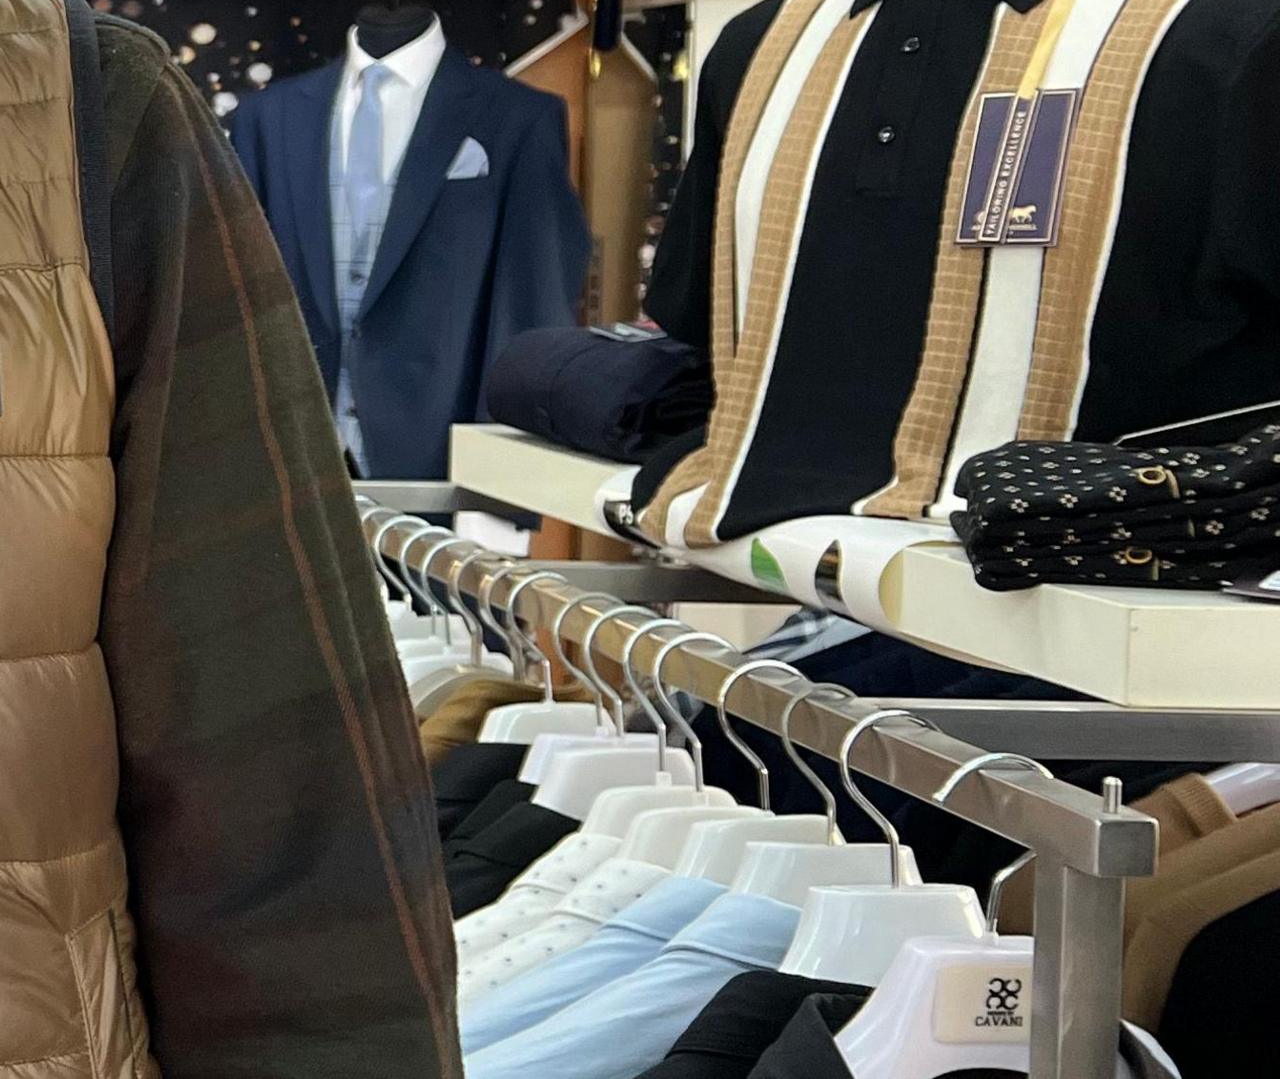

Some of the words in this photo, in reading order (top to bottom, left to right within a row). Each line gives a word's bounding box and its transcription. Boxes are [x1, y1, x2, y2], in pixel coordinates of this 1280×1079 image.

[985, 179, 1009, 236] TAILORING
[1000, 110, 1028, 178] EXCELLENCE
[975, 1016, 1023, 1027] CAVANI
